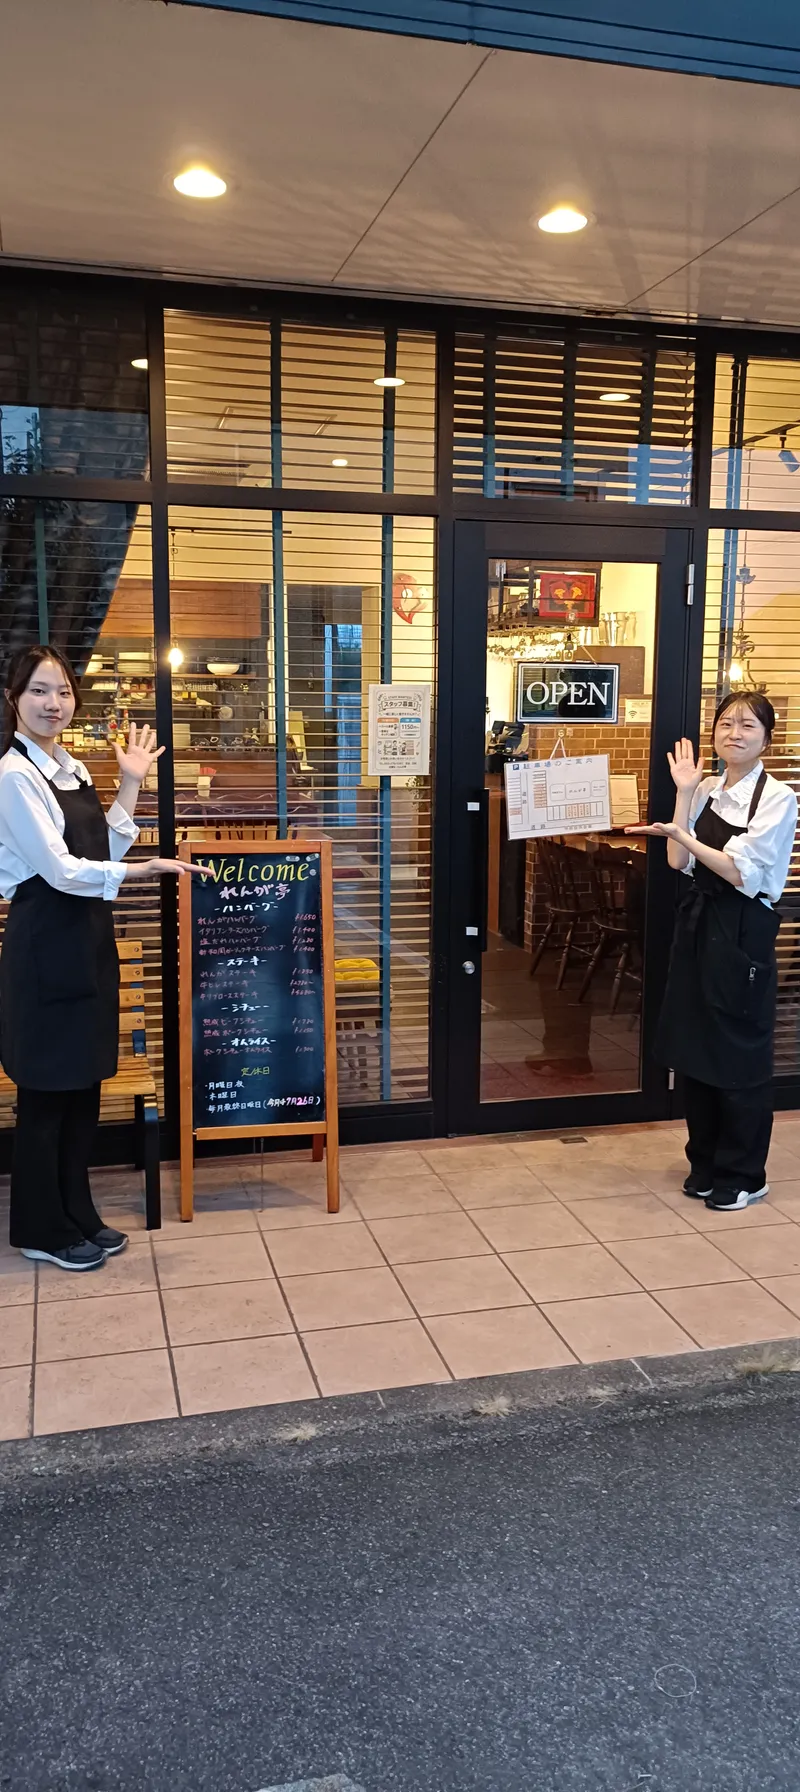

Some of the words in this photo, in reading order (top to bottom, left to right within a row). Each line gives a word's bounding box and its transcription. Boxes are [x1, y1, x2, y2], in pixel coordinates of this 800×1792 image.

[526, 681, 611, 706] OPEN
[196, 858, 309, 883] Welcome
[219, 883, 291, 900] れんが亭
[241, 1066, 270, 1077] 定休日
